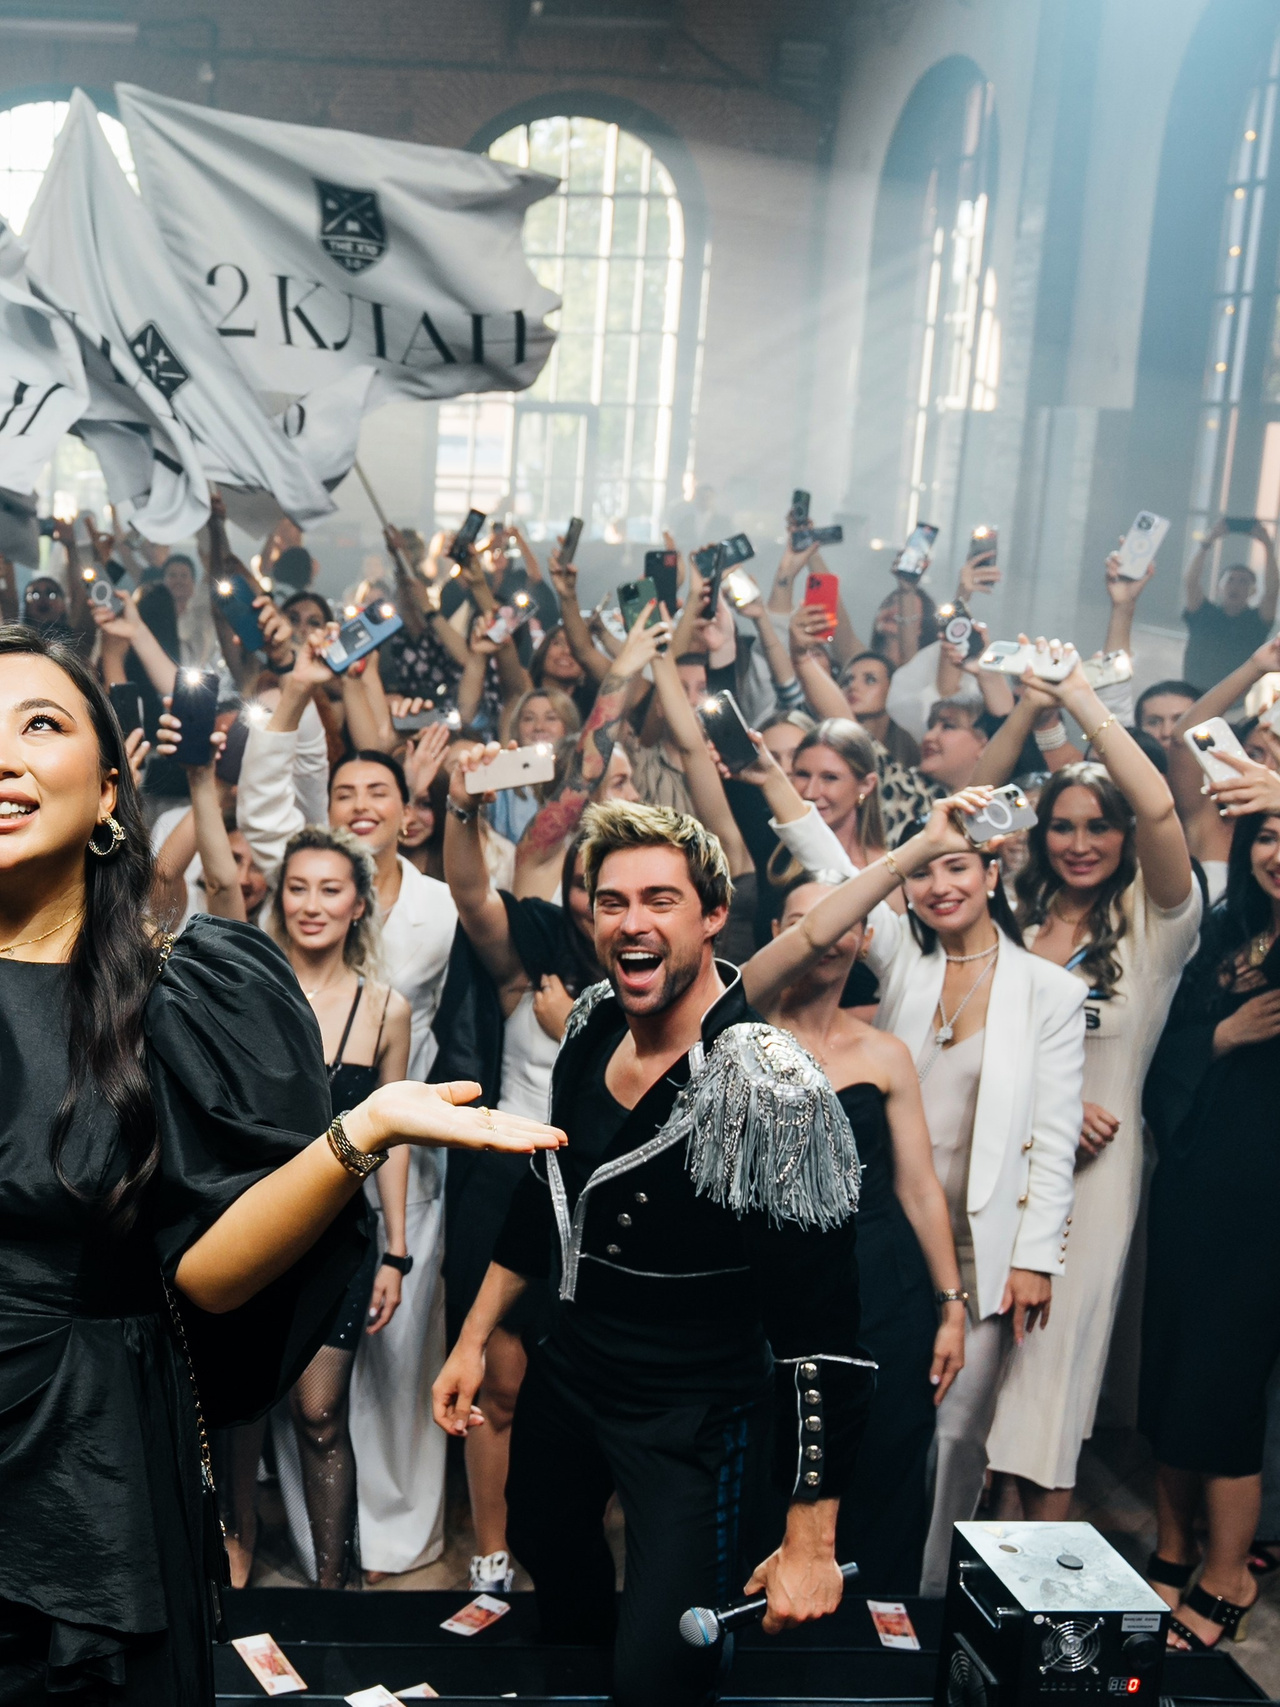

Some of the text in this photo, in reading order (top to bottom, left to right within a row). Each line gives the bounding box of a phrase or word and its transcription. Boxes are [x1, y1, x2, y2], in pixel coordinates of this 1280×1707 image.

[206, 263, 526, 366] 2 КЛАН
[1127, 1677, 1140, 1692] 0
